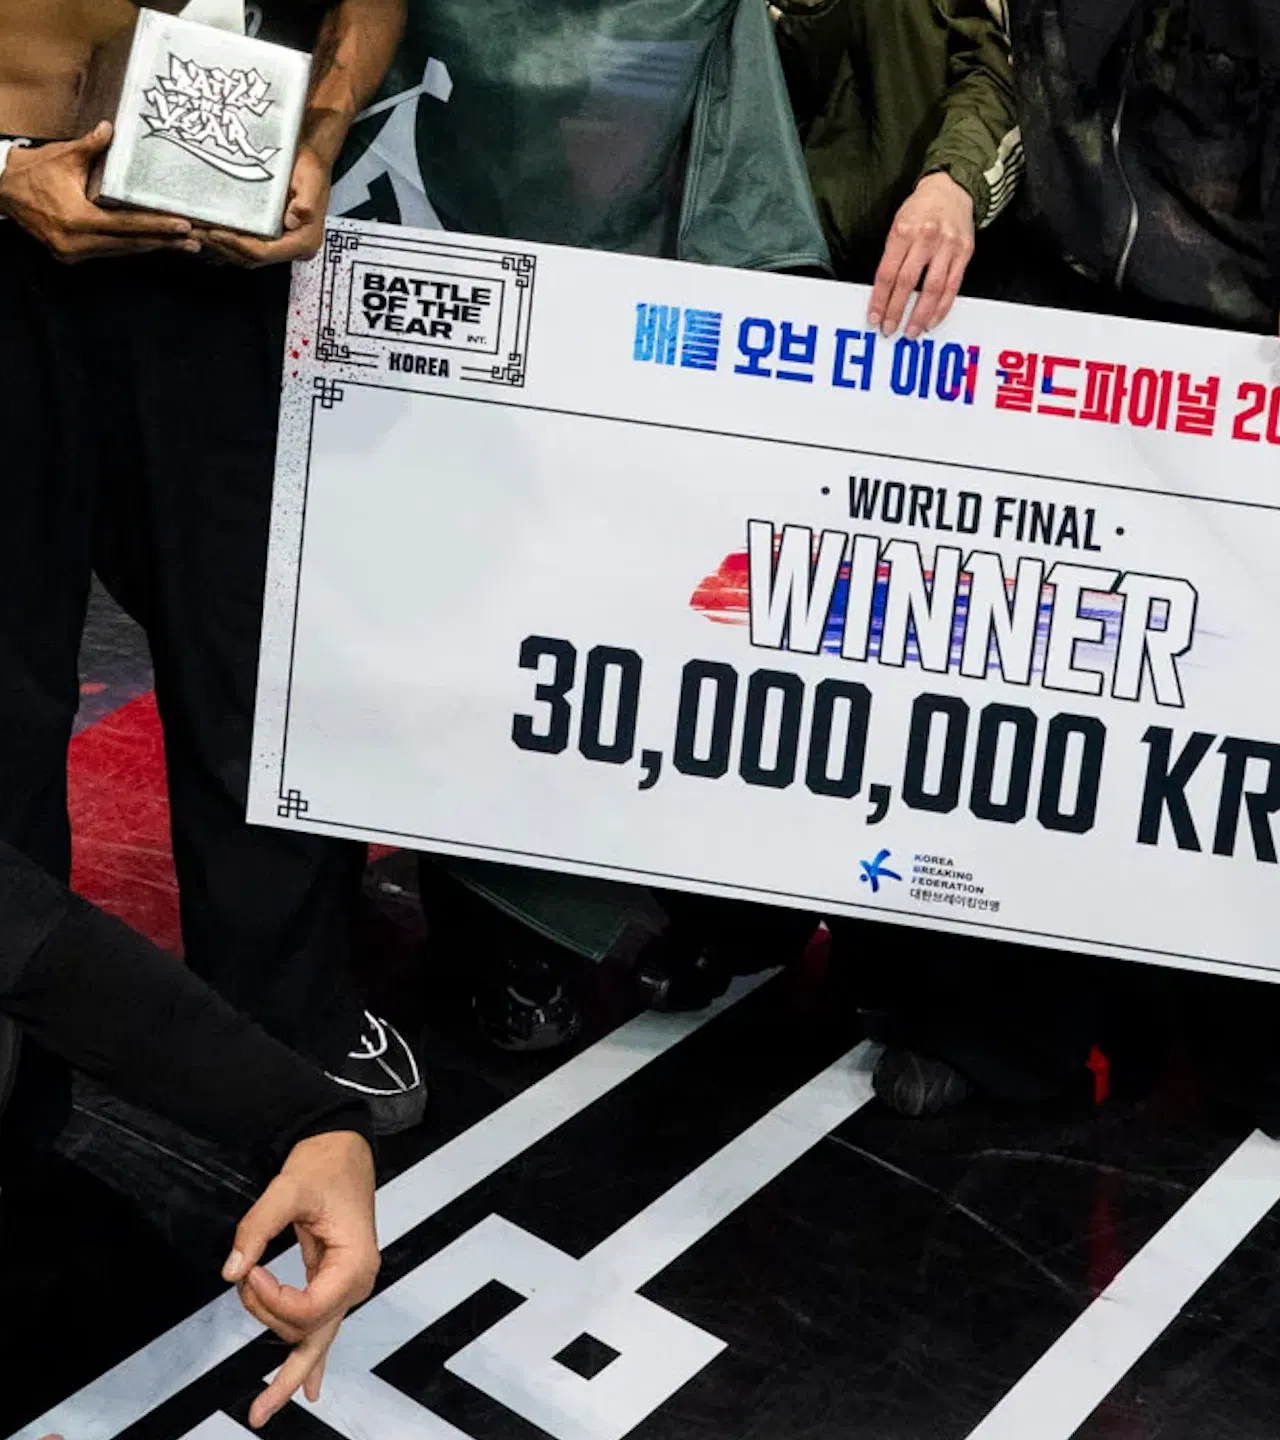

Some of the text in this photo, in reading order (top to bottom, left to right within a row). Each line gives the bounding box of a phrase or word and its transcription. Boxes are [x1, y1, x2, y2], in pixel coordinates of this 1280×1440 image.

[363, 273, 492, 306] BATTLE
[362, 292, 482, 324] OF THE
[362, 311, 488, 345] YEAR INT.
[388, 351, 450, 378] KOREA
[633, 302, 723, 371] 배틀
[734, 316, 819, 383] 오브
[831, 328, 876, 392] 더
[890, 337, 979, 405] 이어
[995, 349, 1218, 437] 월드파이널
[849, 476, 1101, 551] WORLD FINAL
[747, 520, 1198, 707] WINNER
[512, 634, 1106, 835] 30,000,000
[912, 864, 973, 882] BREAKING
[913, 853, 954, 867] KOREA
[910, 888, 1001, 913] 대한브레이킹연맹
[911, 877, 985, 895] FEDERATION
